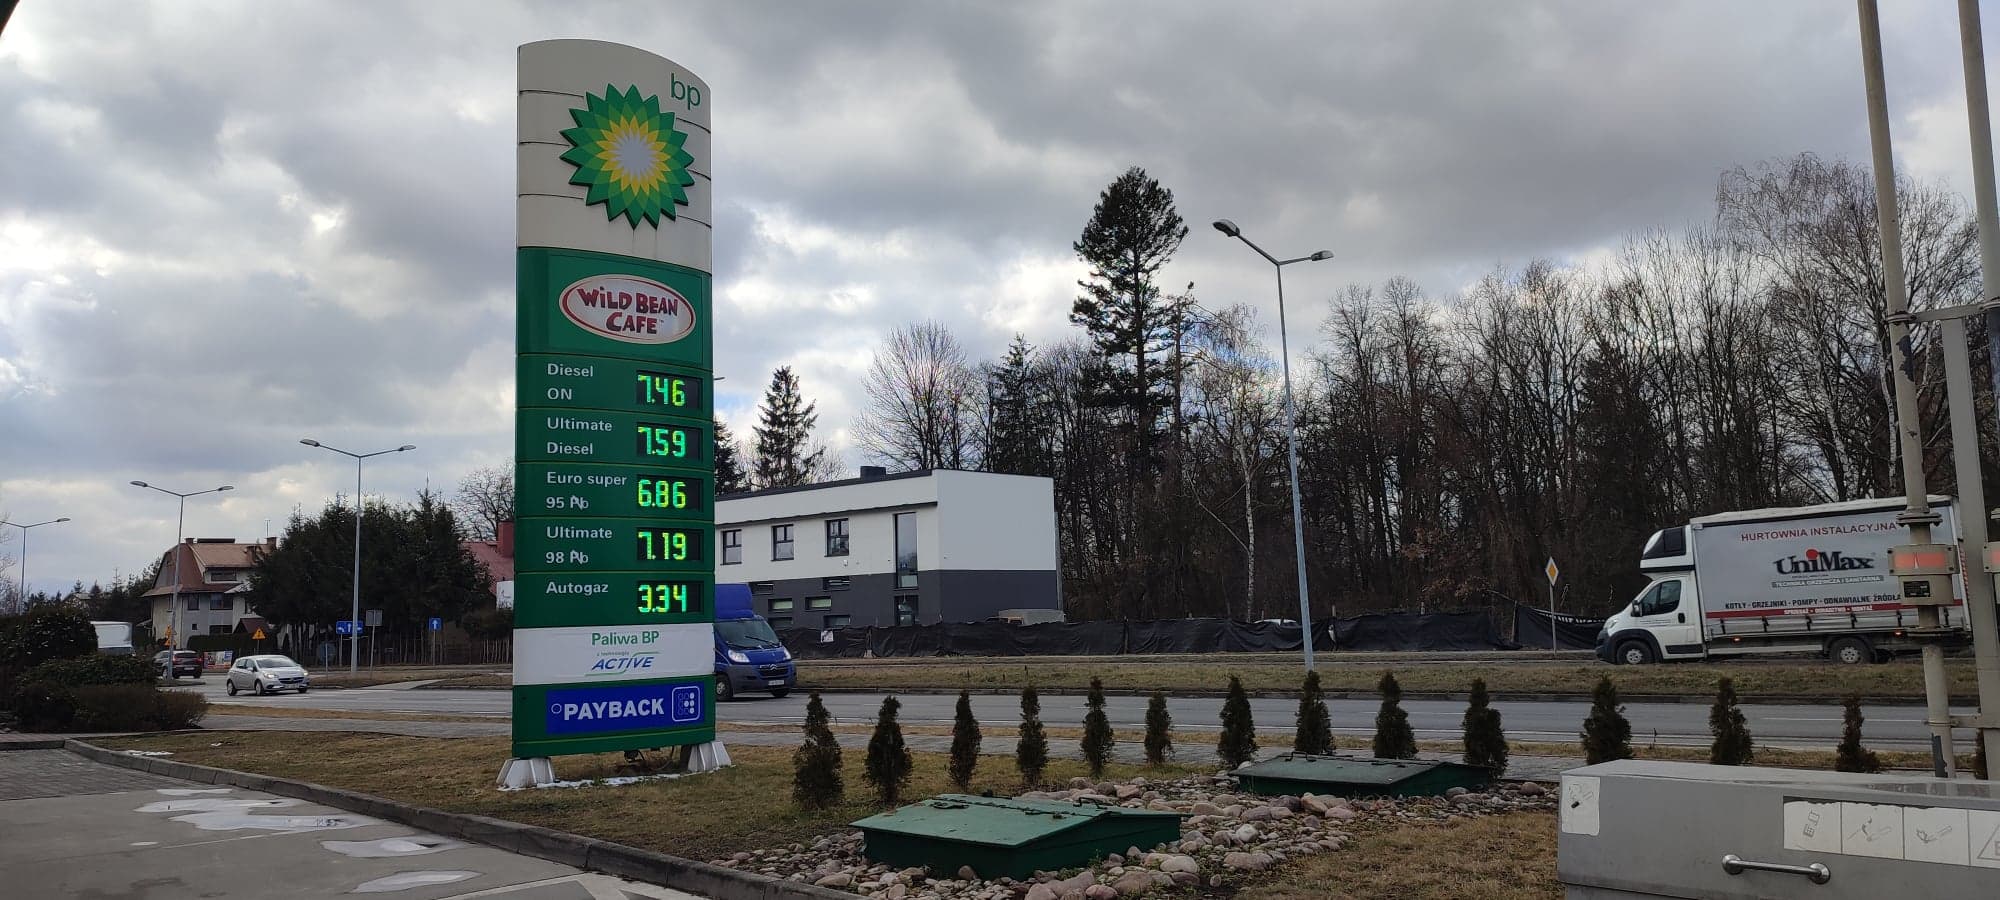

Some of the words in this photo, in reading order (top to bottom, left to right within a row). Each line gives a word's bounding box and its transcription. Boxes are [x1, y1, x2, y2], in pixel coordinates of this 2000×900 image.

[670, 73, 701, 109] bp
[635, 291, 678, 317] BEAN
[606, 312, 657, 334] CAFE
[547, 363, 594, 377] Diesel
[547, 388, 572, 401] ON
[637, 375, 686, 406] 7.46
[547, 417, 613, 432] Ultimate
[547, 442, 593, 455] Diesel
[637, 427, 686, 458] 7.59
[547, 472, 583, 485] Euro
[587, 474, 627, 487] super
[638, 479, 686, 508] 6.86
[546, 497, 565, 509] 95
[546, 526, 613, 539] Ultimate
[1741, 529, 1808, 542] HURTOWNIA
[1810, 522, 1897, 537] INSTALACYJNA
[638, 532, 686, 560] 7.19
[545, 551, 564, 564] 98
[1773, 549, 1874, 575] UniMax
[545, 581, 609, 596] Autogaz
[638, 584, 687, 613] 3.34
[1792, 598, 1818, 607] POMPY
[591, 632, 638, 646] Paliwa
[642, 631, 659, 644] BP
[591, 657, 654, 671] ACTIVE
[563, 698, 665, 721] PAYBACK
